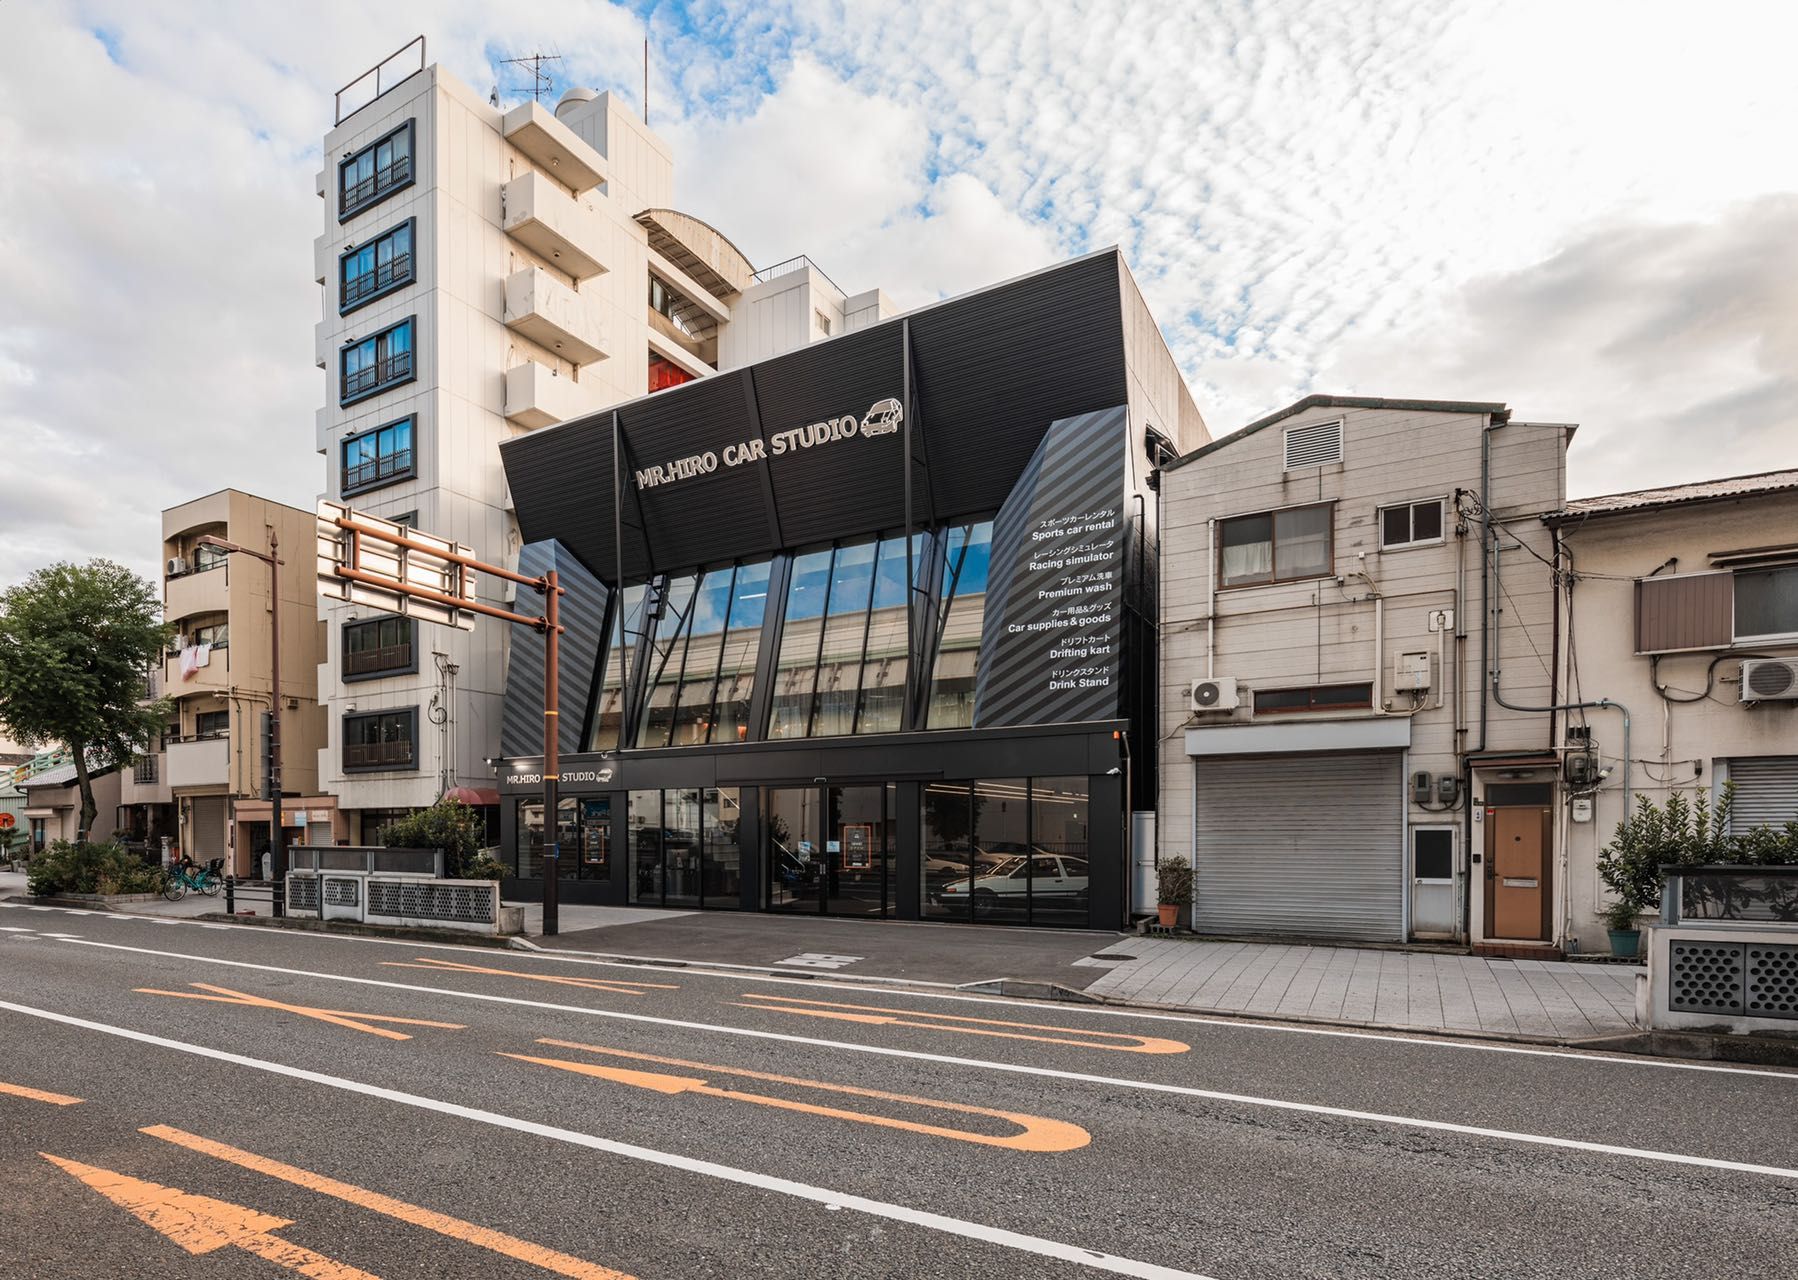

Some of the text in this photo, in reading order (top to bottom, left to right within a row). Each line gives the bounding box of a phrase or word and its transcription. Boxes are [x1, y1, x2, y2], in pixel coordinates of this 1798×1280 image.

[635, 415, 858, 490] MR.HIRO CAR STUDIO
[1040, 509, 1115, 529] スポーツカーレンタル
[1032, 518, 1115, 541] Sports car rental
[1033, 540, 1114, 559] レーシングシミュレータ
[1029, 551, 1114, 571] Racing simulator
[1060, 571, 1113, 586] プレミアム洗車
[1038, 582, 1112, 600] Premium wash
[1008, 624, 1026, 633] Car
[1061, 634, 1111, 647] ドリフトカート
[1050, 645, 1111, 659] Drifting kart
[1052, 665, 1110, 679] ドリンクスタンド
[1049, 676, 1109, 690] Drink Stand
[506, 774, 541, 784] MR.HIRO
[562, 771, 596, 782] STUDIO
